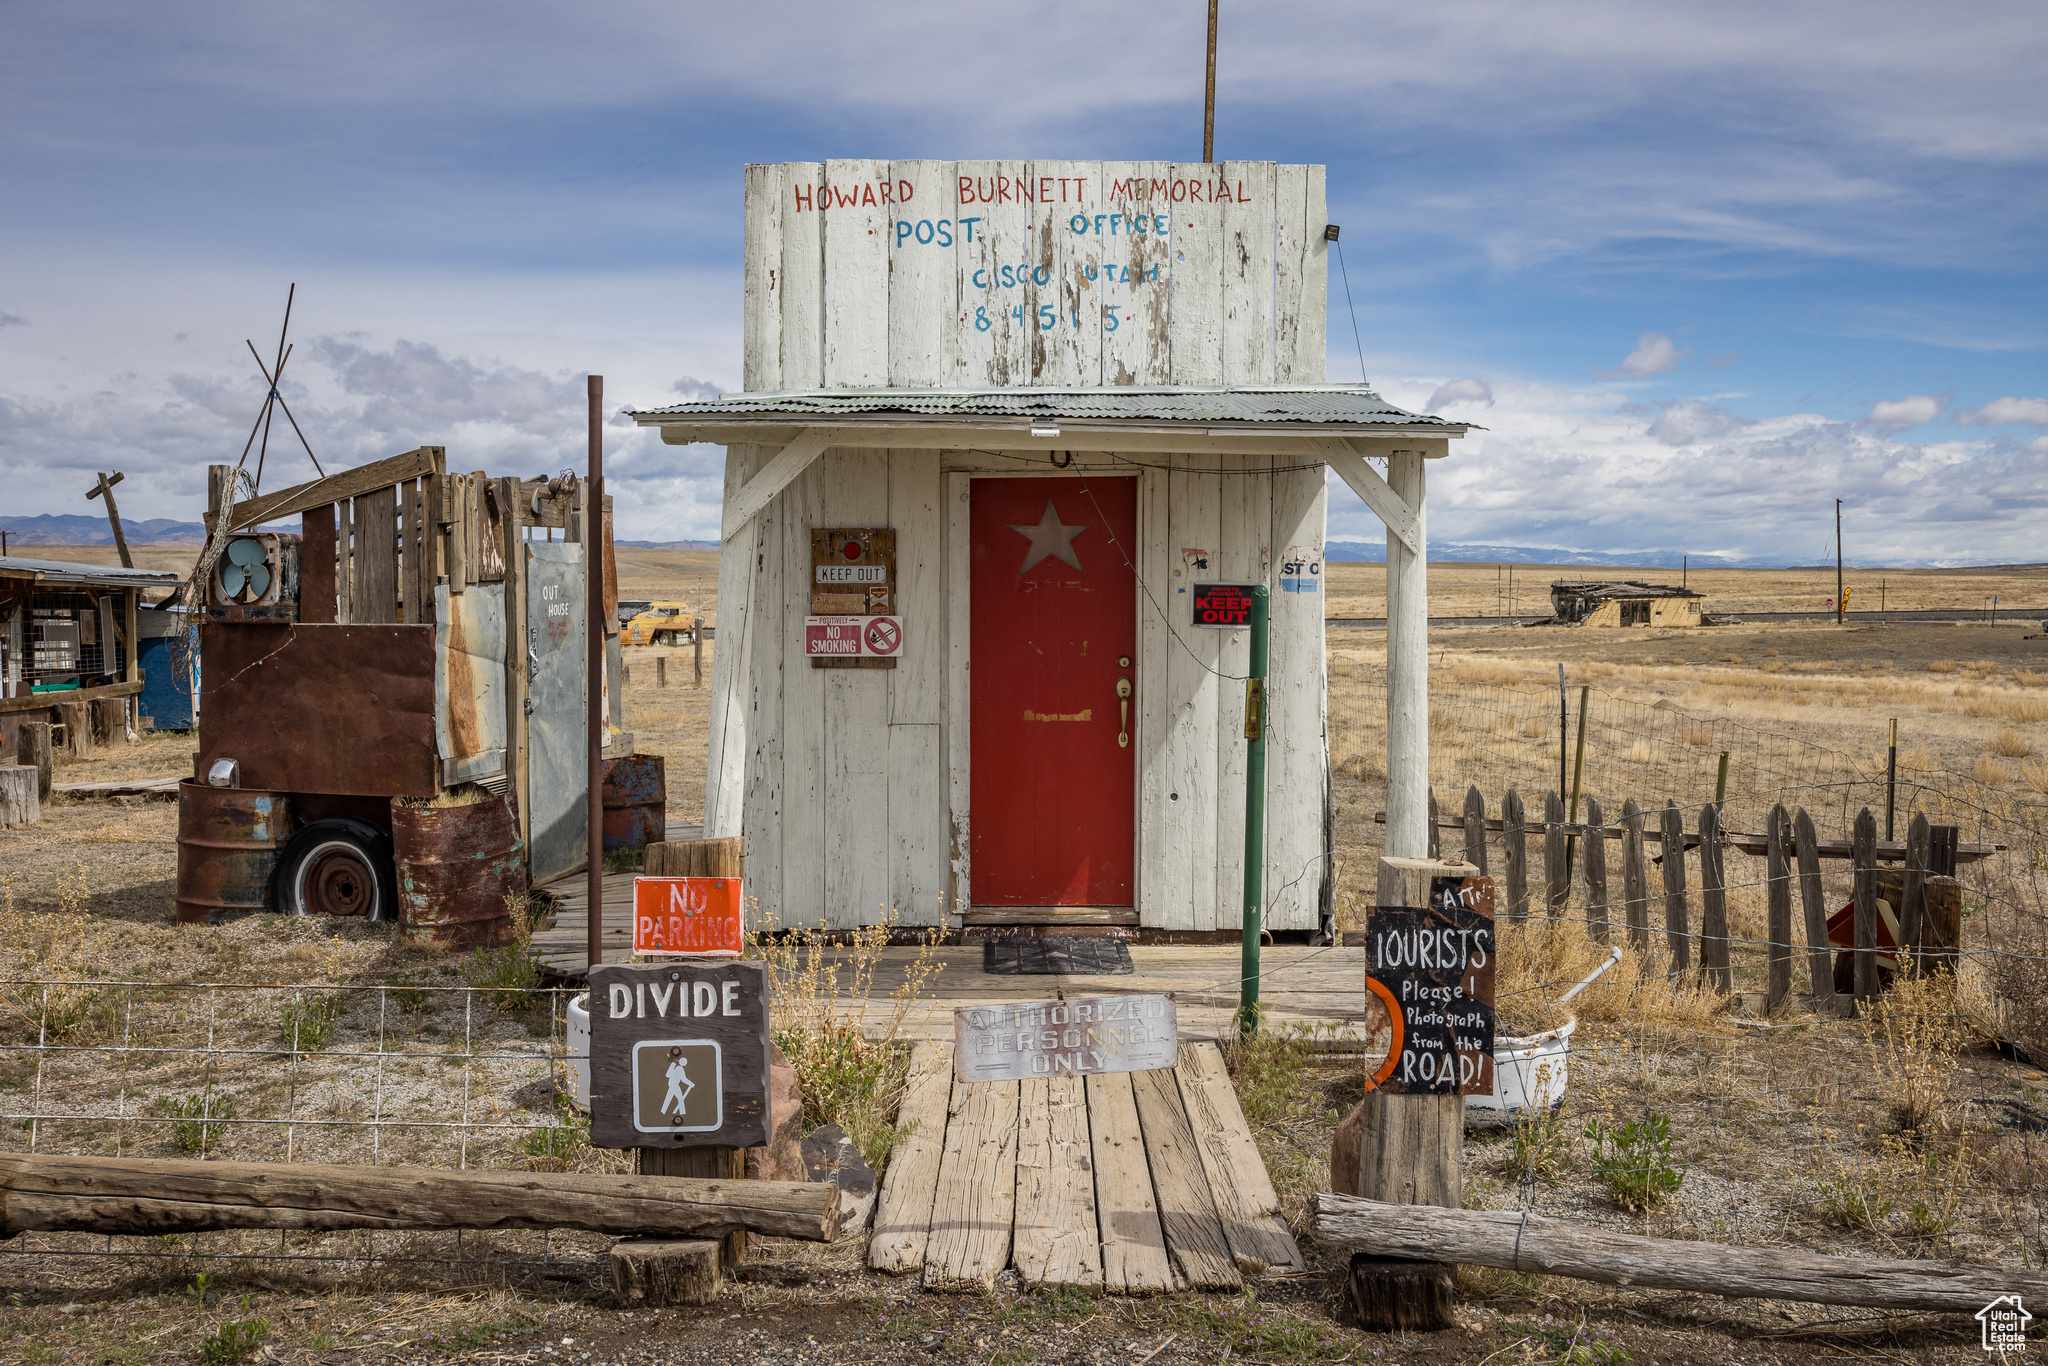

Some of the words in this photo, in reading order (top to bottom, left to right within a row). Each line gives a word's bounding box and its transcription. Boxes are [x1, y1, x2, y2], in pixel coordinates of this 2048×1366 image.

[794, 179, 914, 213] HOWARD
[959, 175, 1088, 204] BURNETT
[1110, 176, 1252, 204] MEMORIAL
[896, 216, 982, 248] POST
[1069, 213, 1169, 236] OFFICE
[972, 263, 1050, 289] CISCO
[1084, 262, 1159, 284] UTAH
[822, 568, 852, 581] KEEP
[857, 568, 880, 581] OUT
[1281, 562, 1304, 575] ST
[542, 584, 559, 600] OUT
[548, 602, 570, 617] HOUSE
[1195, 597, 1252, 610] KEEP
[818, 617, 849, 625] POSITIVELY
[1202, 610, 1248, 623] OUT
[826, 626, 841, 639] NO
[811, 639, 857, 653] SMOKING
[669, 883, 708, 915] NO
[639, 916, 737, 948] PARKING
[608, 980, 742, 1019] DIVIDE
[966, 999, 1166, 1031] AUTHORIZED
[975, 1025, 1163, 1054] PERSONNEL
[1412, 1031, 1443, 1050] from
[1455, 1035, 1483, 1051] the
[1031, 1050, 1109, 1074] ONLY
[1403, 1049, 1484, 1087] ROAD!
